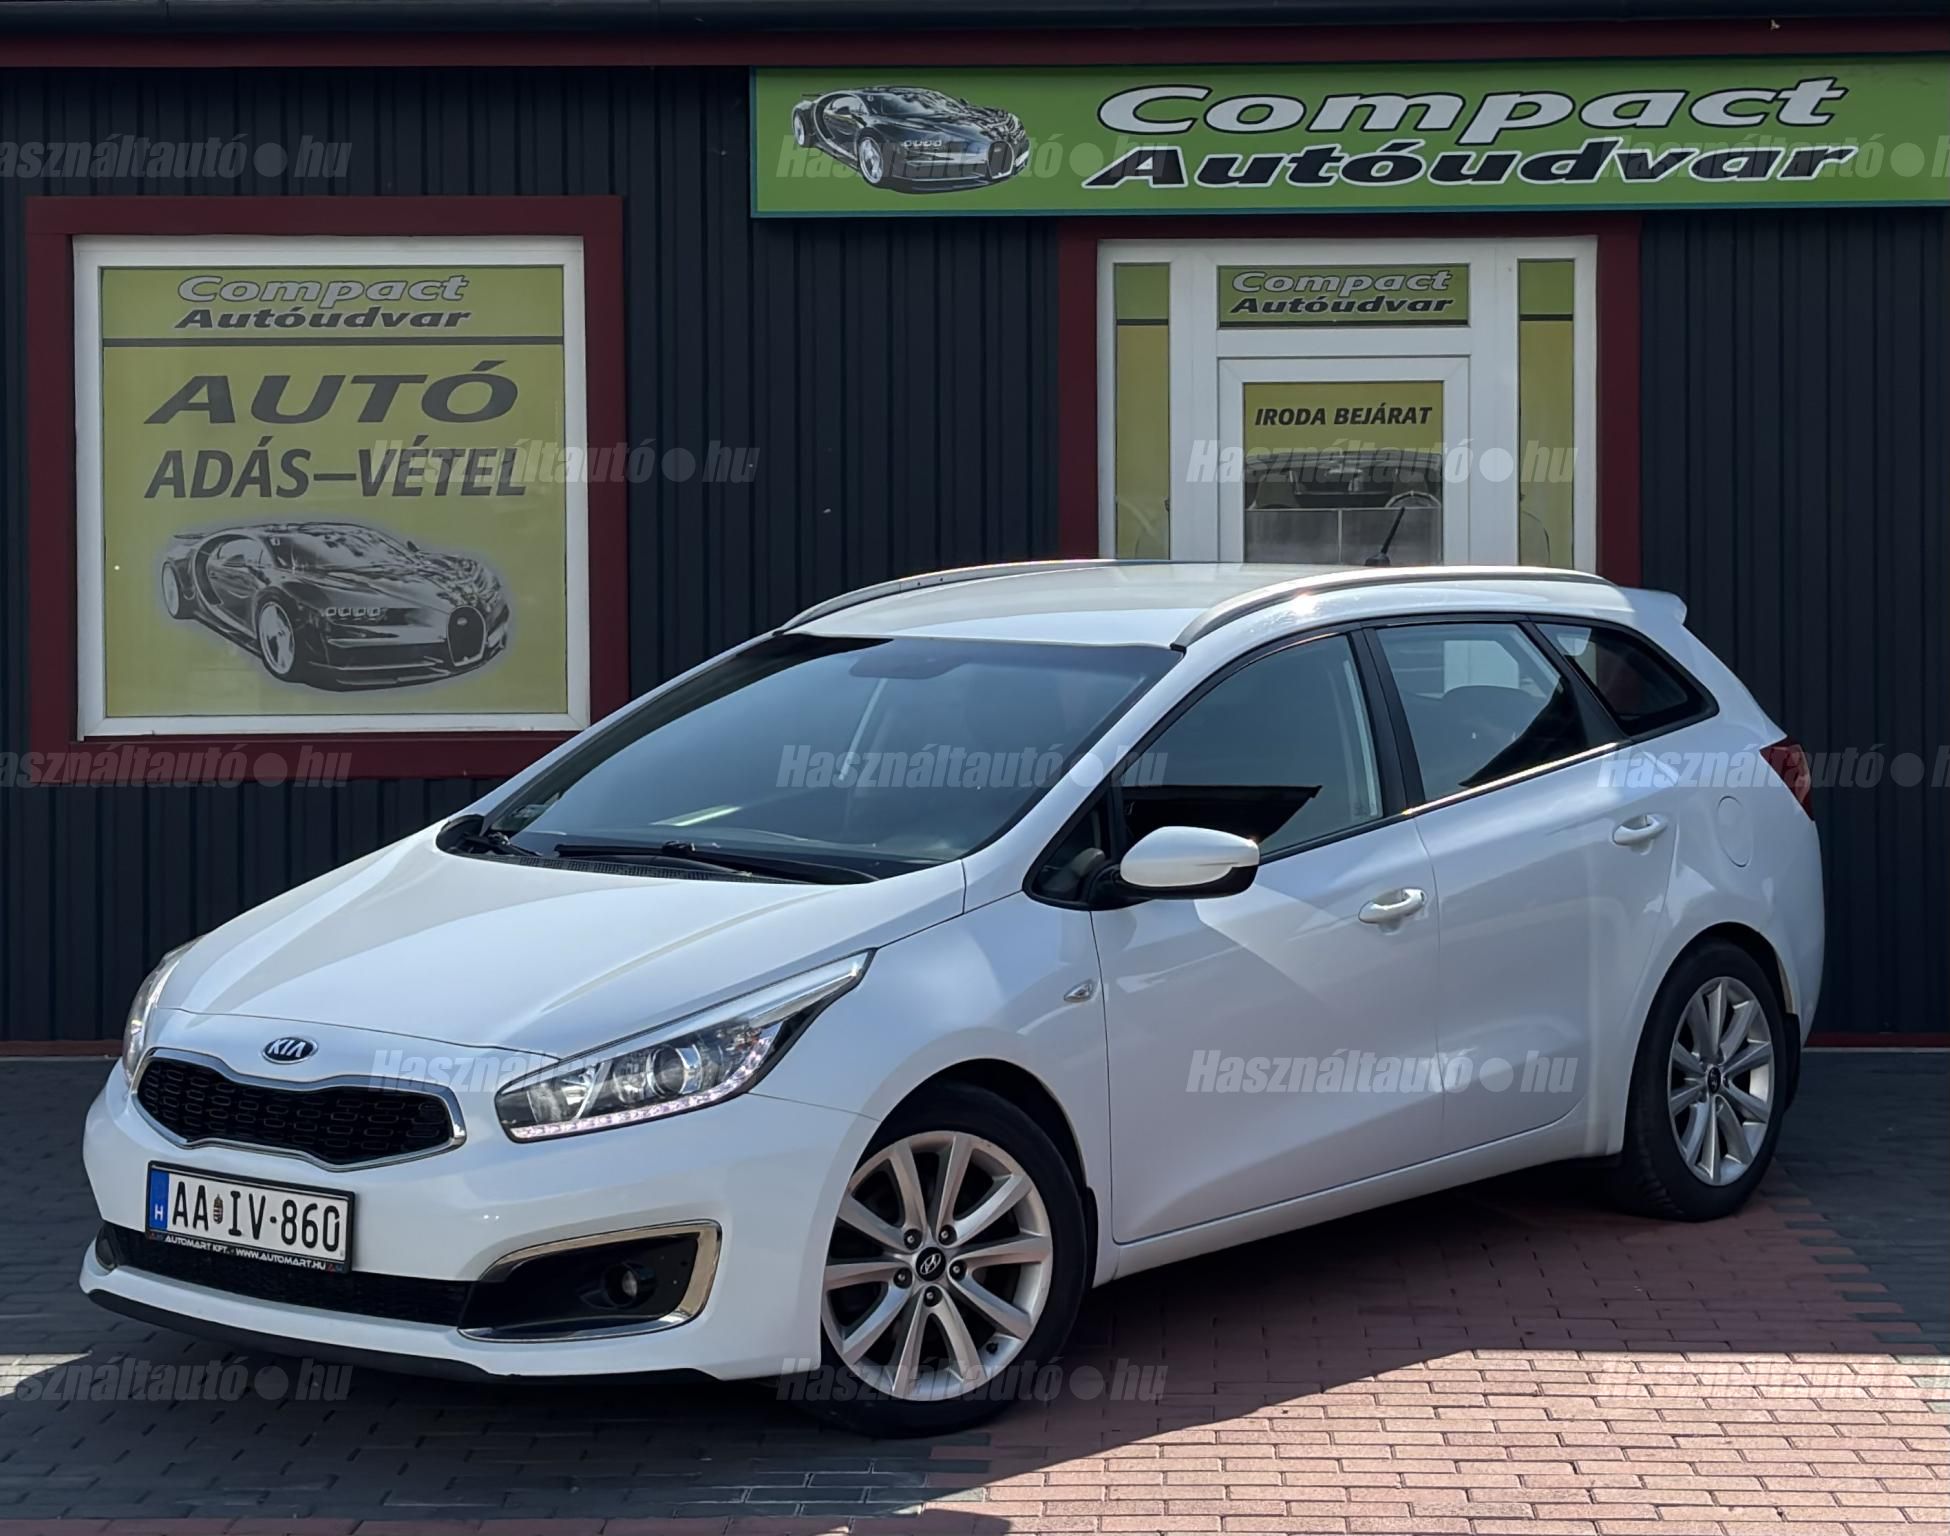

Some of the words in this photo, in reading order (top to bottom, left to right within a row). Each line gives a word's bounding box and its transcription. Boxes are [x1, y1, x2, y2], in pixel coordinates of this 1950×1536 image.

[1098, 76, 1848, 146] Compact
[1081, 137, 1858, 189] Autóudvar
[178, 275, 469, 309] Compact
[1232, 269, 1453, 297] Compact
[175, 303, 471, 331] Autóudvar
[1230, 294, 1454, 315] Autóudvar
[144, 360, 519, 425] AUTÓ
[1255, 408, 1326, 426] IRODA
[1333, 402, 1433, 426] BEJÁRAT
[266, 1038, 305, 1058] KIA
[154, 1204, 163, 1221] H
[165, 1235, 211, 1252] AUTOMART
[236, 1247, 326, 1271] WWW.AUTOMART.HU
